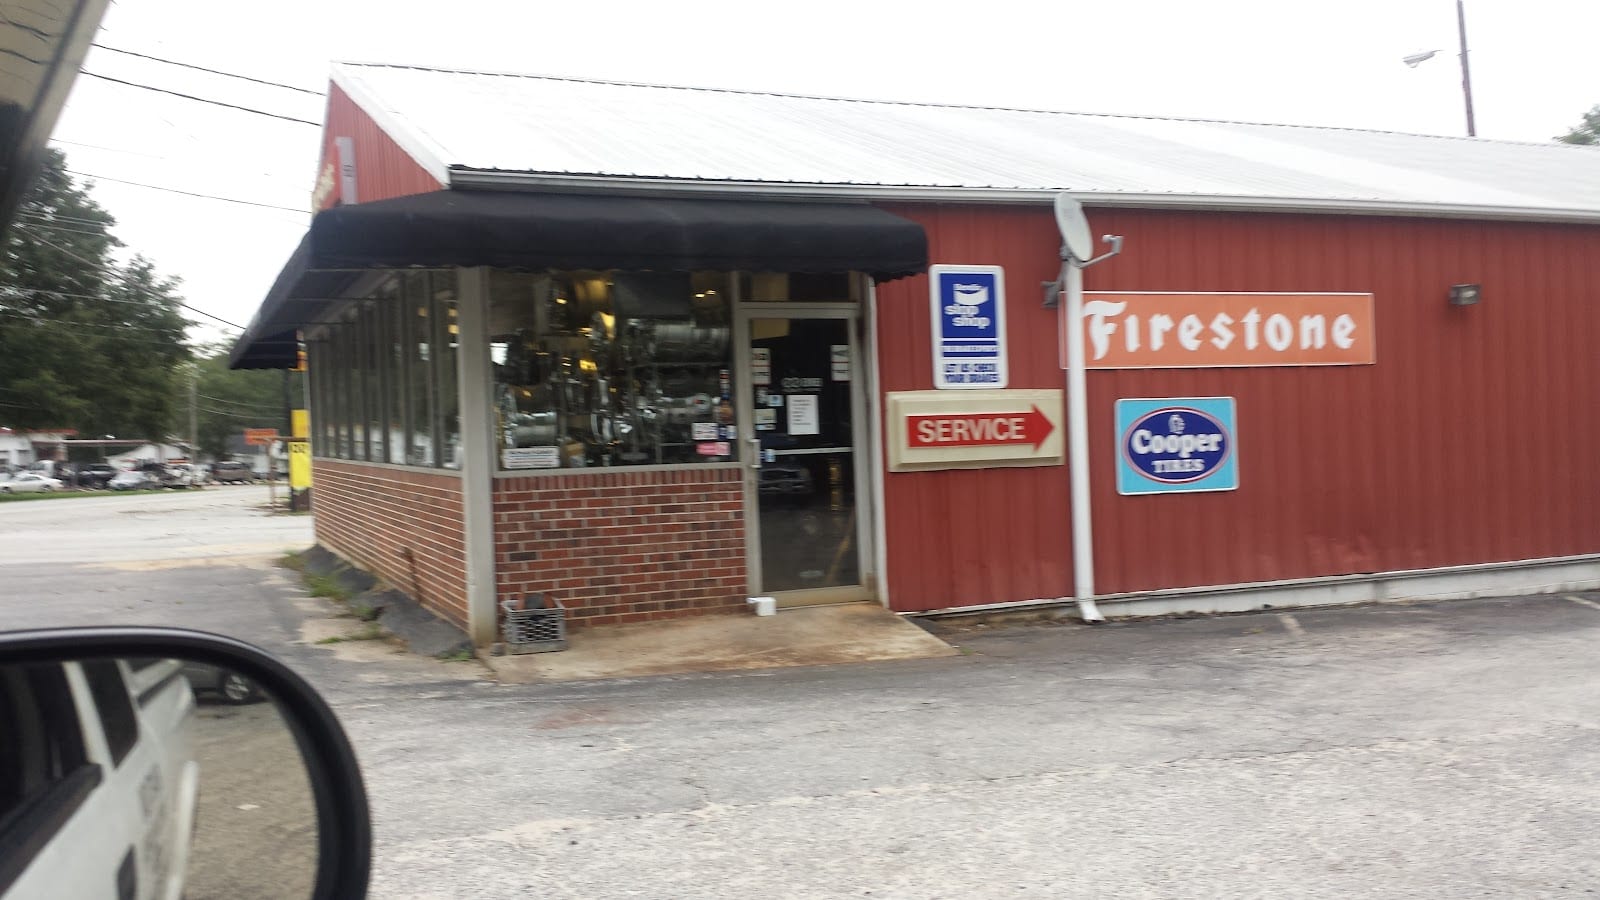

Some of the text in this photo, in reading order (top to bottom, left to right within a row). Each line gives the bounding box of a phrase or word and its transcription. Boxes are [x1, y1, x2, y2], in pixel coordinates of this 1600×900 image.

[1082, 300, 1357, 361] Firestone
[917, 417, 1026, 443] SERVICE
[1130, 429, 1223, 458] Cooper
[1151, 459, 1205, 473] TIRES
